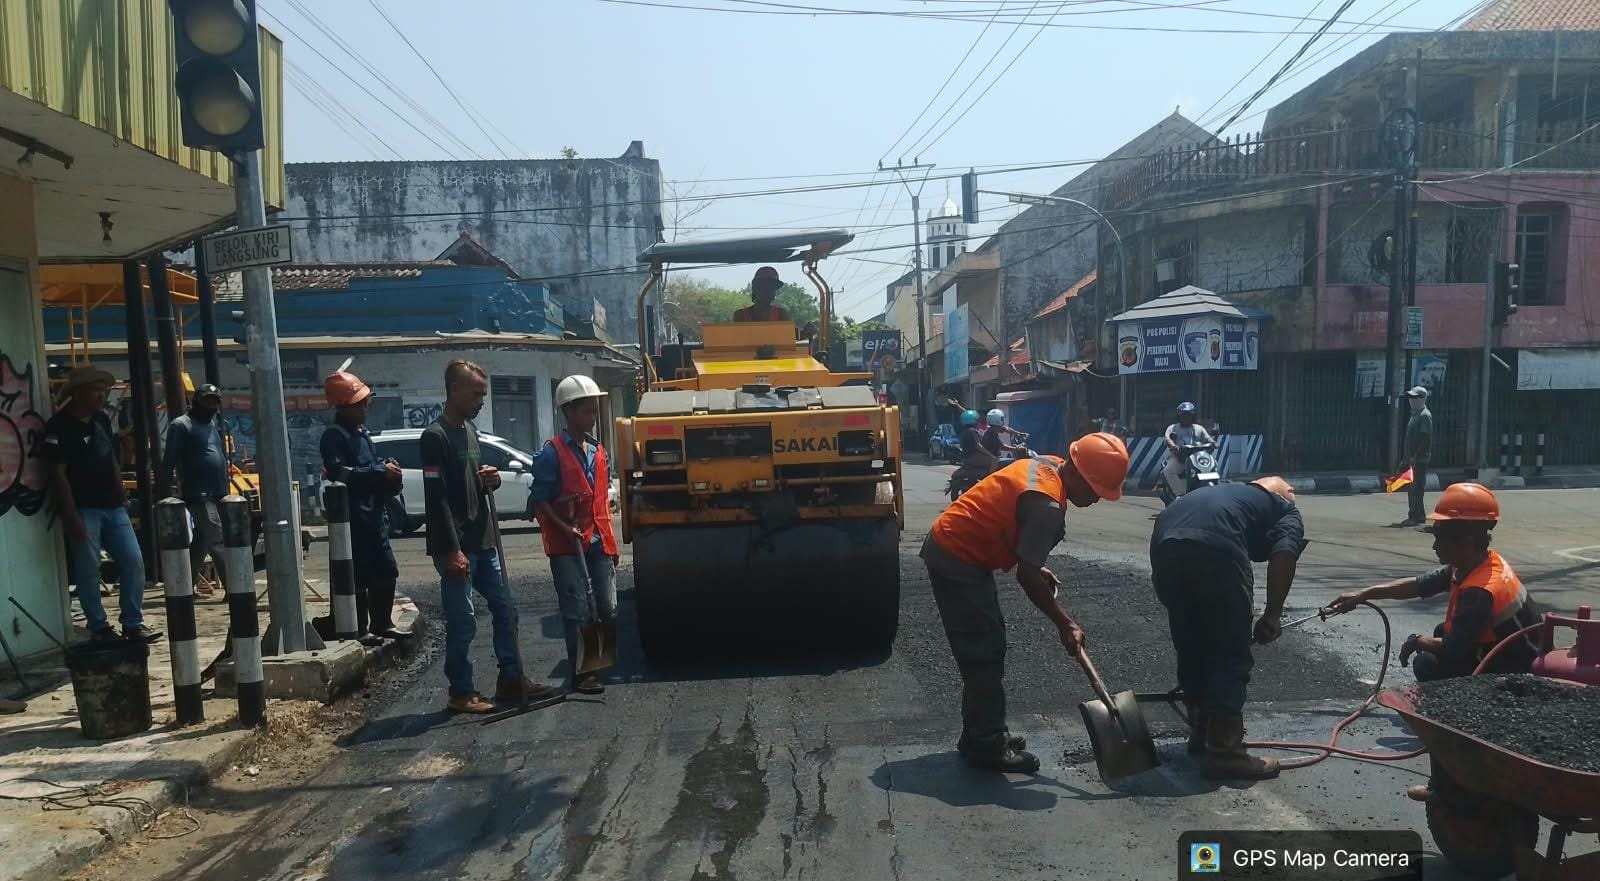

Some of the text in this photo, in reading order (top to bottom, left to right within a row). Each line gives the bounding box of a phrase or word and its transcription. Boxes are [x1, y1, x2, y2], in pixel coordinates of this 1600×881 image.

[214, 231, 279, 254] BELOK KIRI
[215, 244, 280, 266] LANGSUNG
[1146, 328, 1158, 337] POS
[1158, 326, 1177, 336] POLISI
[864, 339, 886, 351] elf
[774, 436, 838, 453] SAKAI
